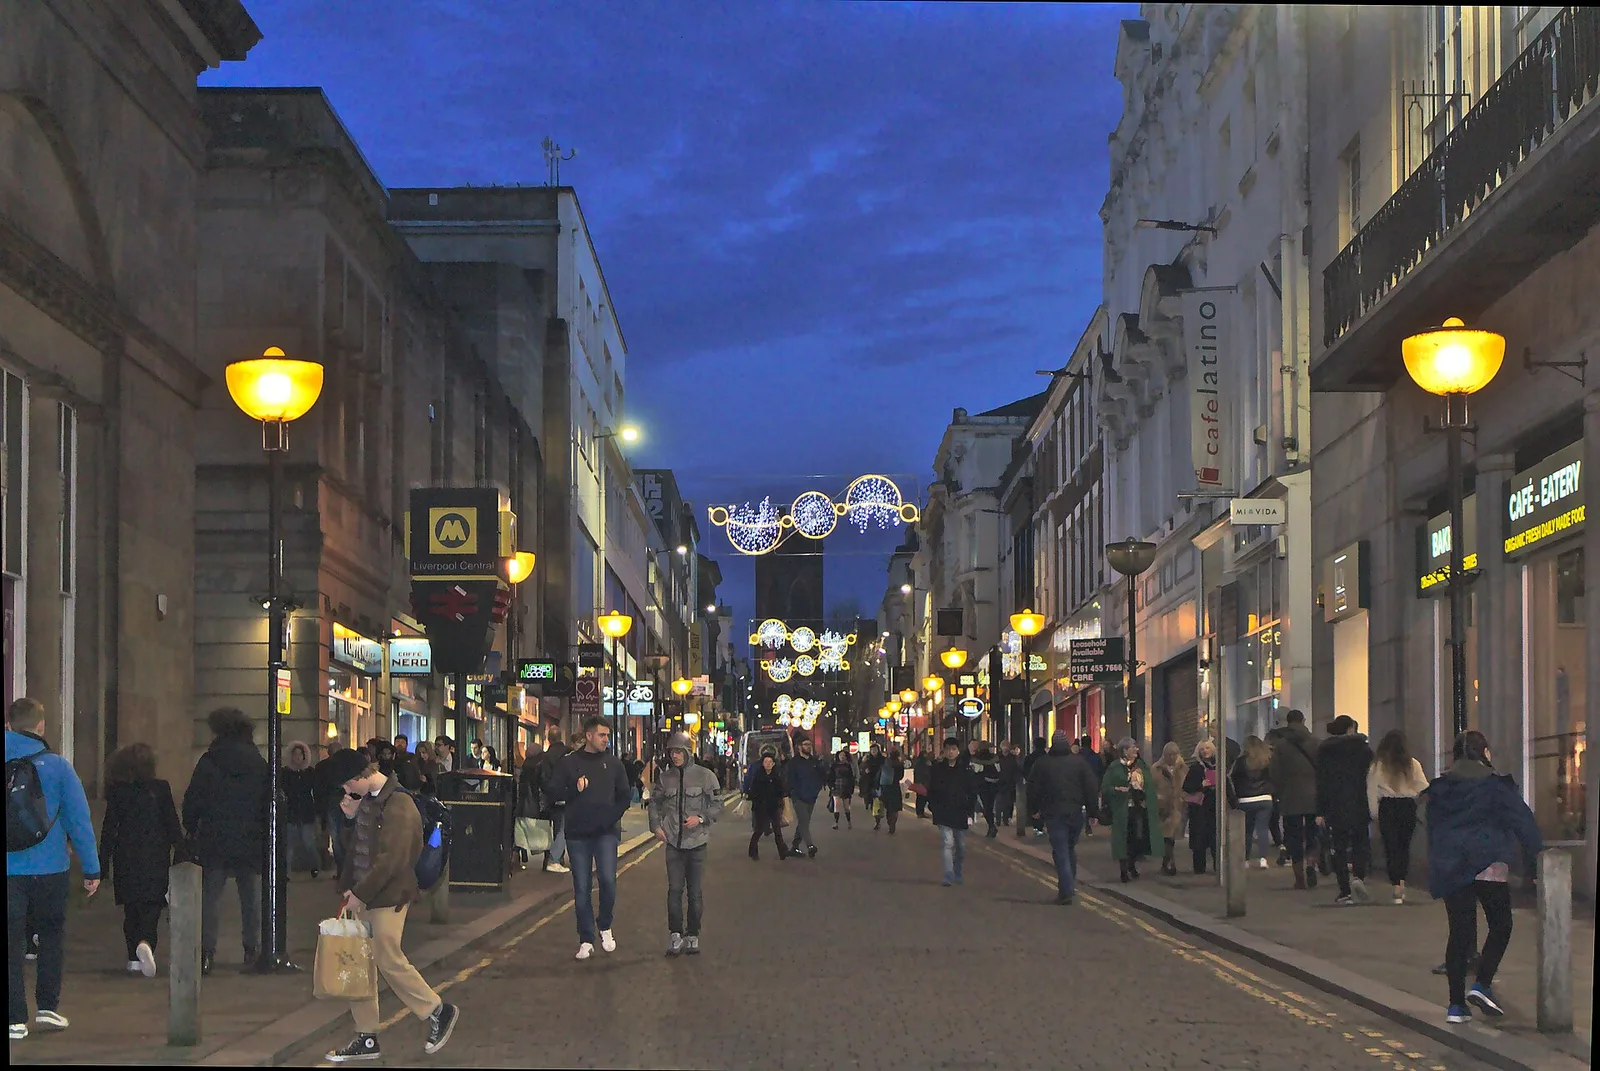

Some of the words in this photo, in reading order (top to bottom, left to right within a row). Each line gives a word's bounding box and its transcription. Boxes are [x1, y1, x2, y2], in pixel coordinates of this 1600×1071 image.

[1509, 477, 1534, 521] CAFÉ
[1541, 460, 1581, 507] EATERY
[1526, 525, 1541, 544] FRESH
[1541, 518, 1556, 538] DAILY
[1556, 511, 1571, 531] MADE
[413, 561, 457, 571] Liverpool
[459, 561, 495, 571] Central
[1072, 639, 1107, 648] Leasehold
[1072, 648, 1105, 656] Available
[391, 658, 429, 667] NERO
[1071, 665, 1088, 673] 0161
[1090, 664, 1104, 672] 455
[1071, 673, 1094, 682] CBRE
